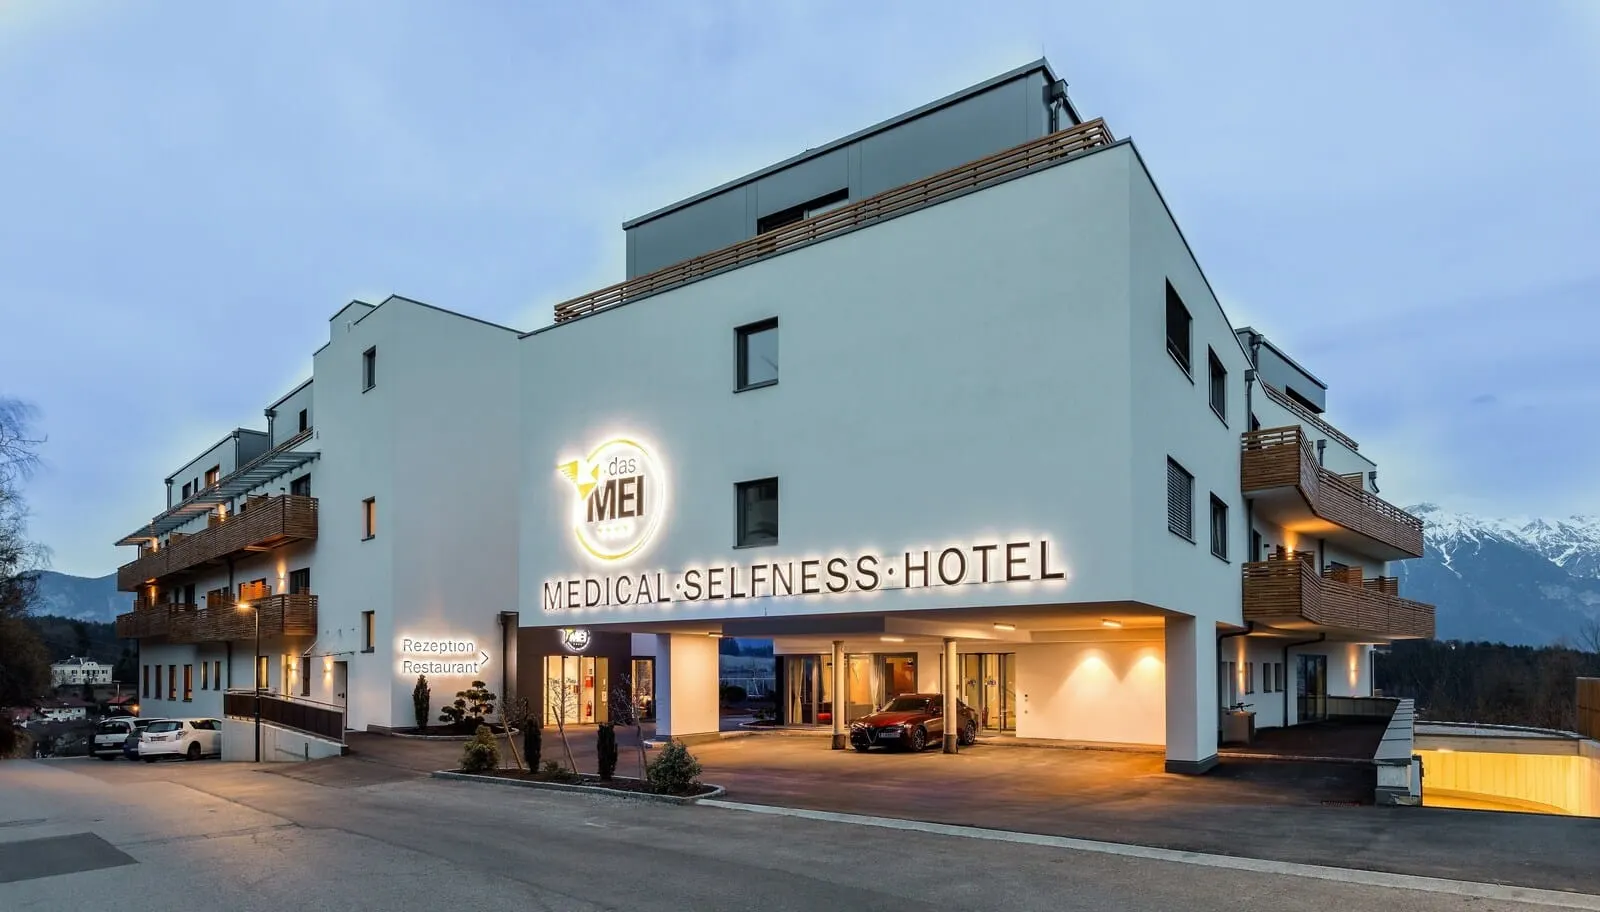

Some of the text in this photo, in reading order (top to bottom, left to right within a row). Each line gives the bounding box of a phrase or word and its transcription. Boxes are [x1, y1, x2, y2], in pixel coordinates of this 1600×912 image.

[609, 457, 637, 476] das
[587, 475, 645, 523] MEI
[905, 541, 1065, 587] HOTEL
[403, 639, 474, 654] Rezeption
[403, 660, 479, 673] Restaurant
